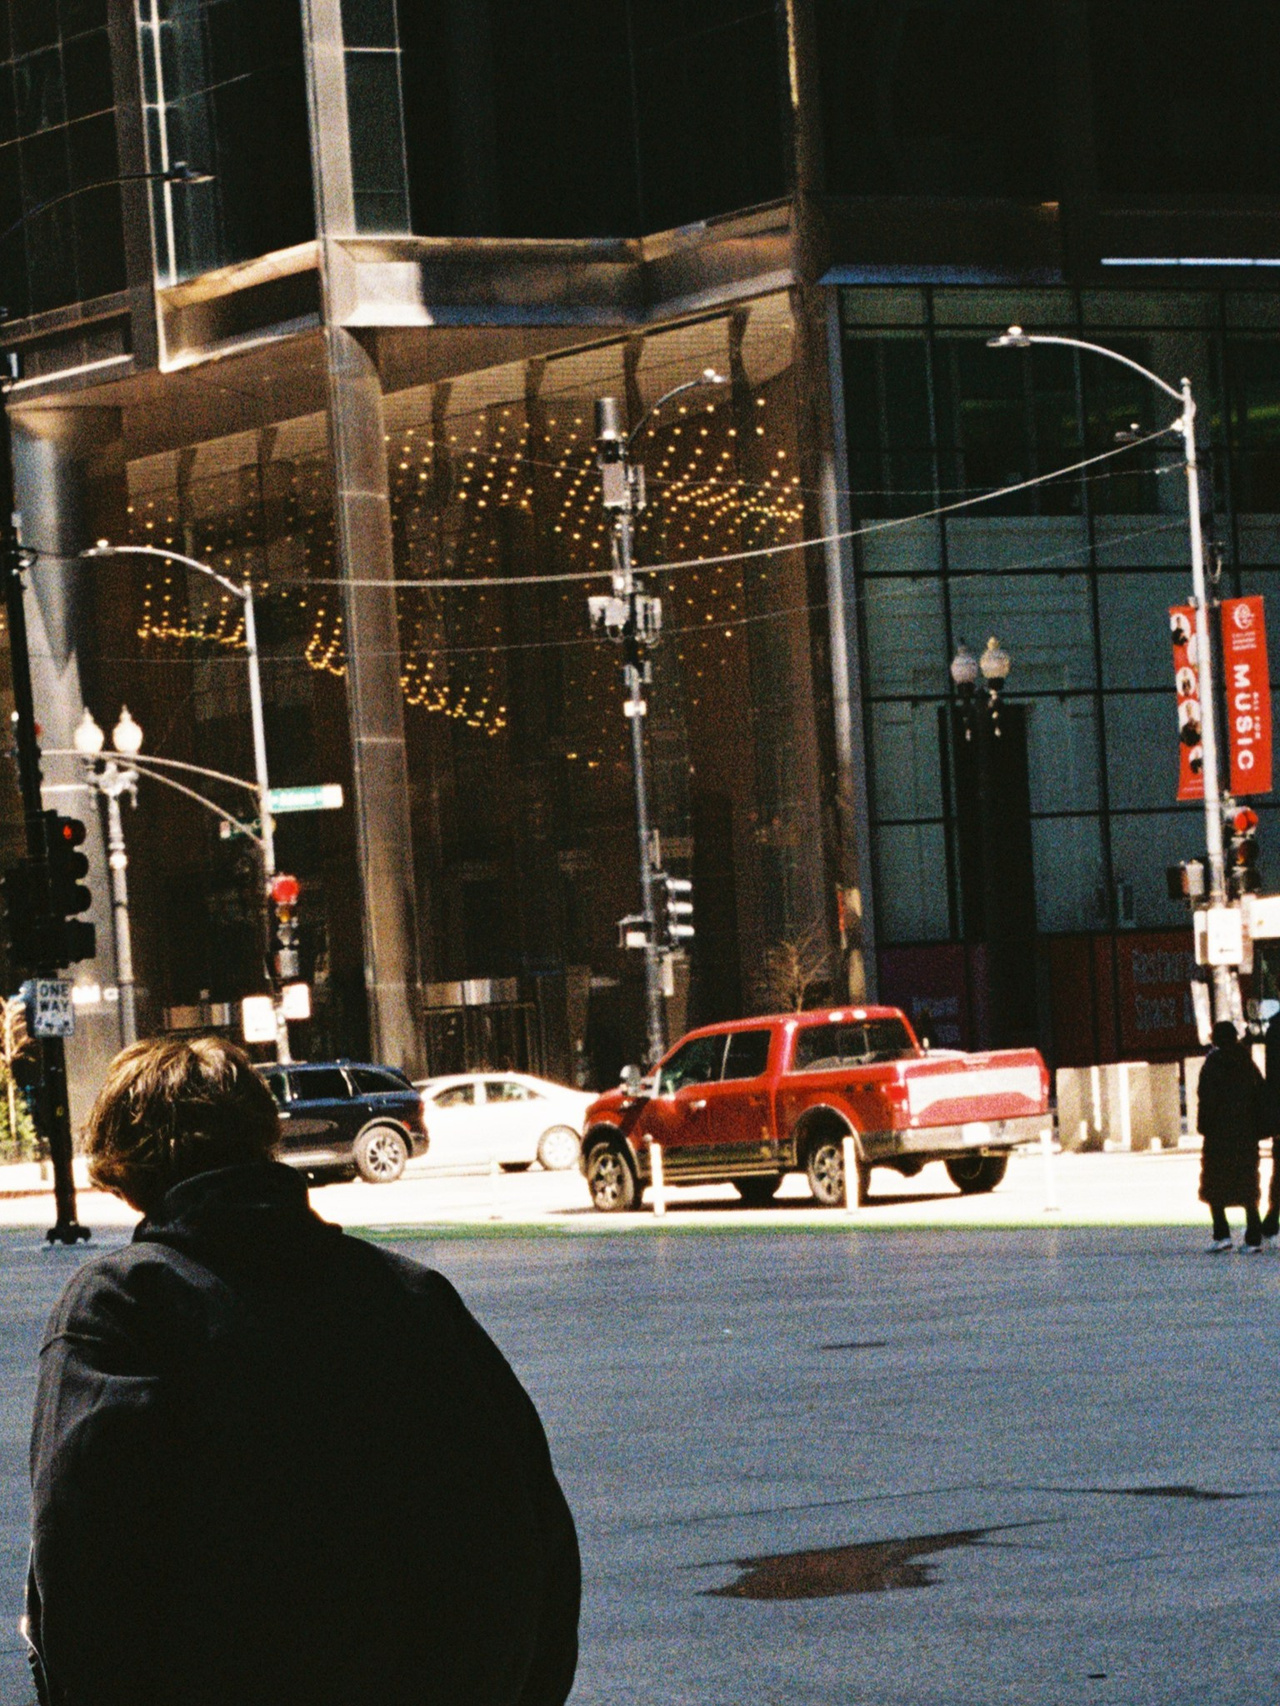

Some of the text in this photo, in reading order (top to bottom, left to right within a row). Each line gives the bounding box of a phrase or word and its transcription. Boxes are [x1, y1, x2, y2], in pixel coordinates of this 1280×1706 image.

[1233, 664, 1254, 770] MUSIC
[40, 984, 69, 997] ONE
[40, 1001, 68, 1013] WAY
